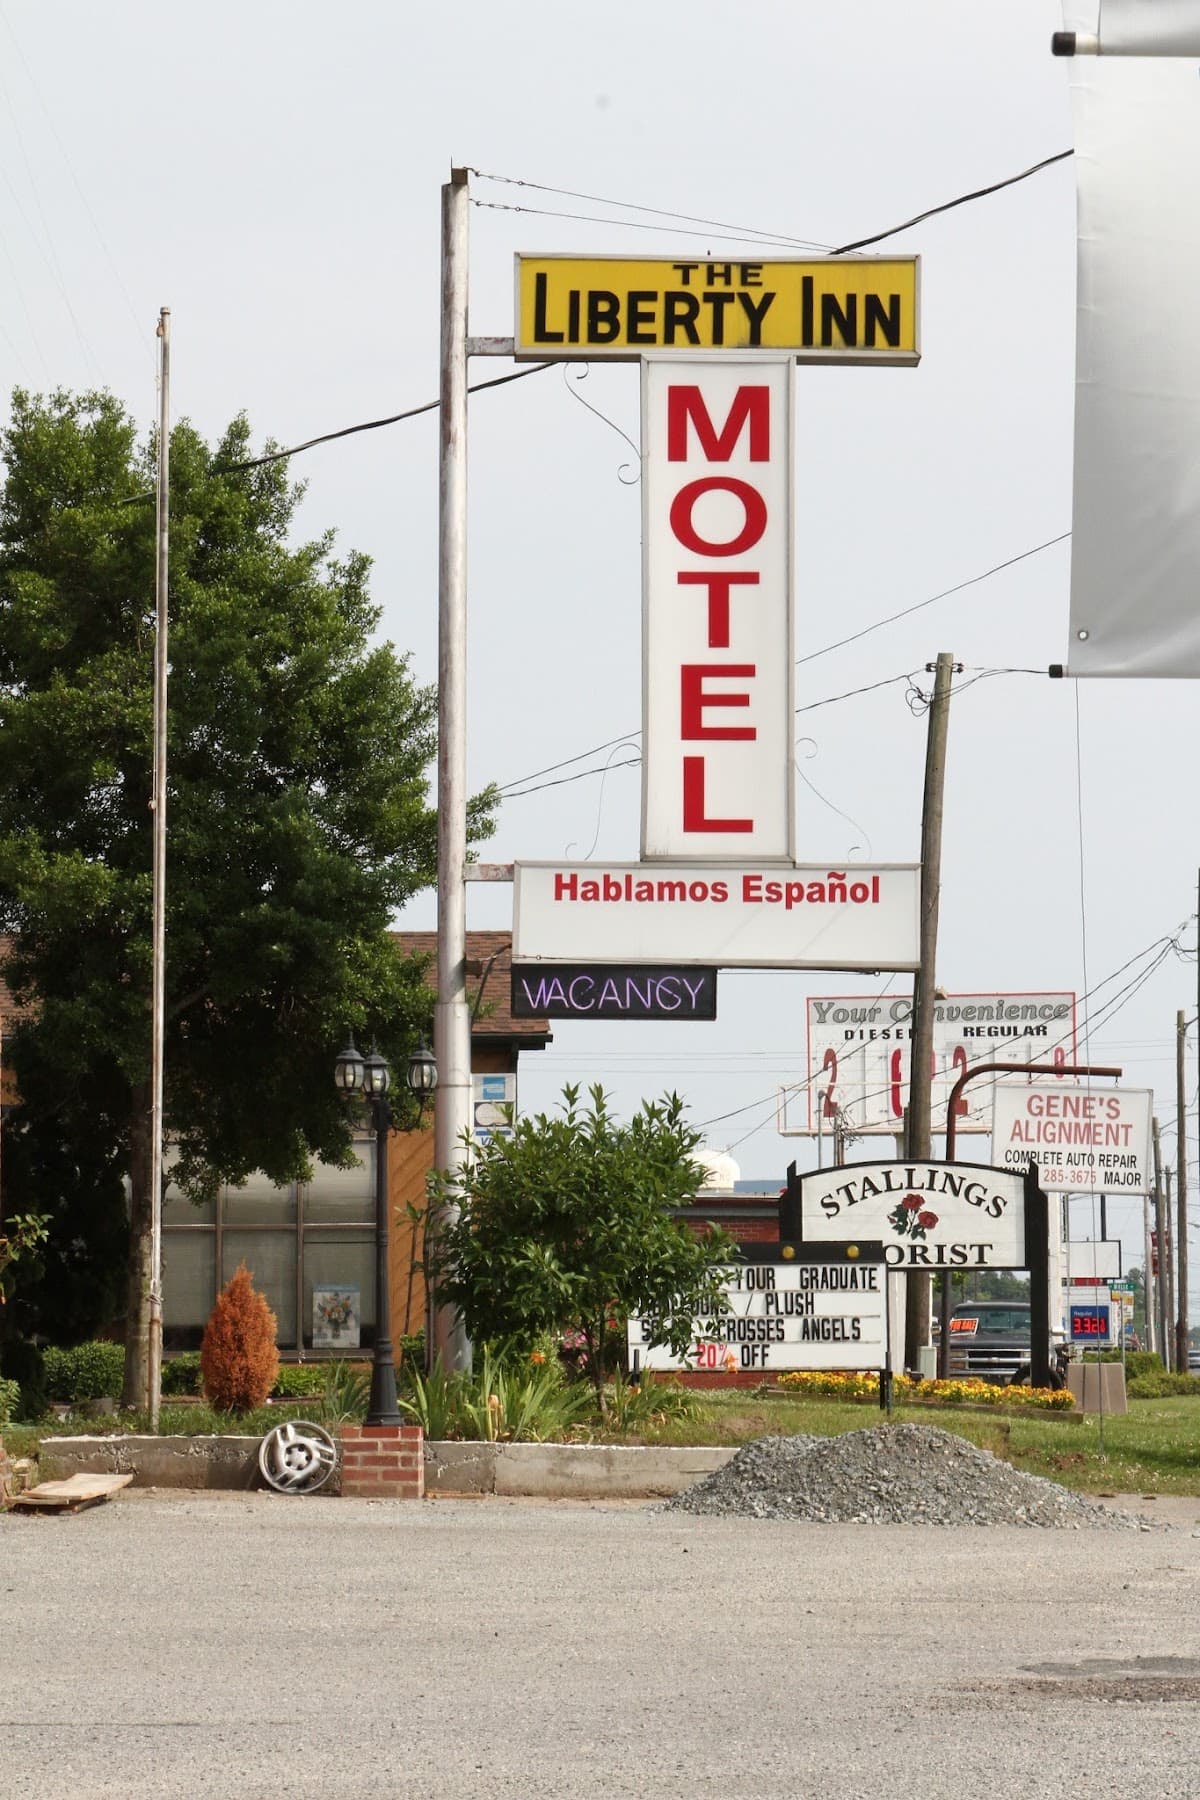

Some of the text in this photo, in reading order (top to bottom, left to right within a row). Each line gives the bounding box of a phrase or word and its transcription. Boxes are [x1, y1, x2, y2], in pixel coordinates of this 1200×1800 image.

[672, 264, 763, 286] THE
[534, 272, 901, 346] LIBERTY INN
[668, 385, 770, 833] MOTEL
[554, 872, 881, 910] Hablamos Español
[521, 975, 706, 1011] VACANCY
[813, 1000, 1069, 1024] Your Cnvenience
[963, 1025, 1048, 1038] REGULAR
[1026, 1094, 1121, 1120] GENE'S
[1010, 1119, 1133, 1147] ALIGNMENT
[1004, 1149, 1137, 1169] COMPLETE AUTO REPAIR
[1103, 1171, 1142, 1186] MAJOR
[819, 1168, 1008, 1220] STALLINGS
[883, 1244, 993, 1266] ORIST
[735, 1266, 776, 1291] YOUR
[799, 1266, 878, 1291] GRADUATE
[765, 1292, 815, 1316] PLUSH
[718, 1318, 786, 1342] CROSSES
[801, 1318, 861, 1341] ANGELS
[740, 1344, 770, 1367] OFF
